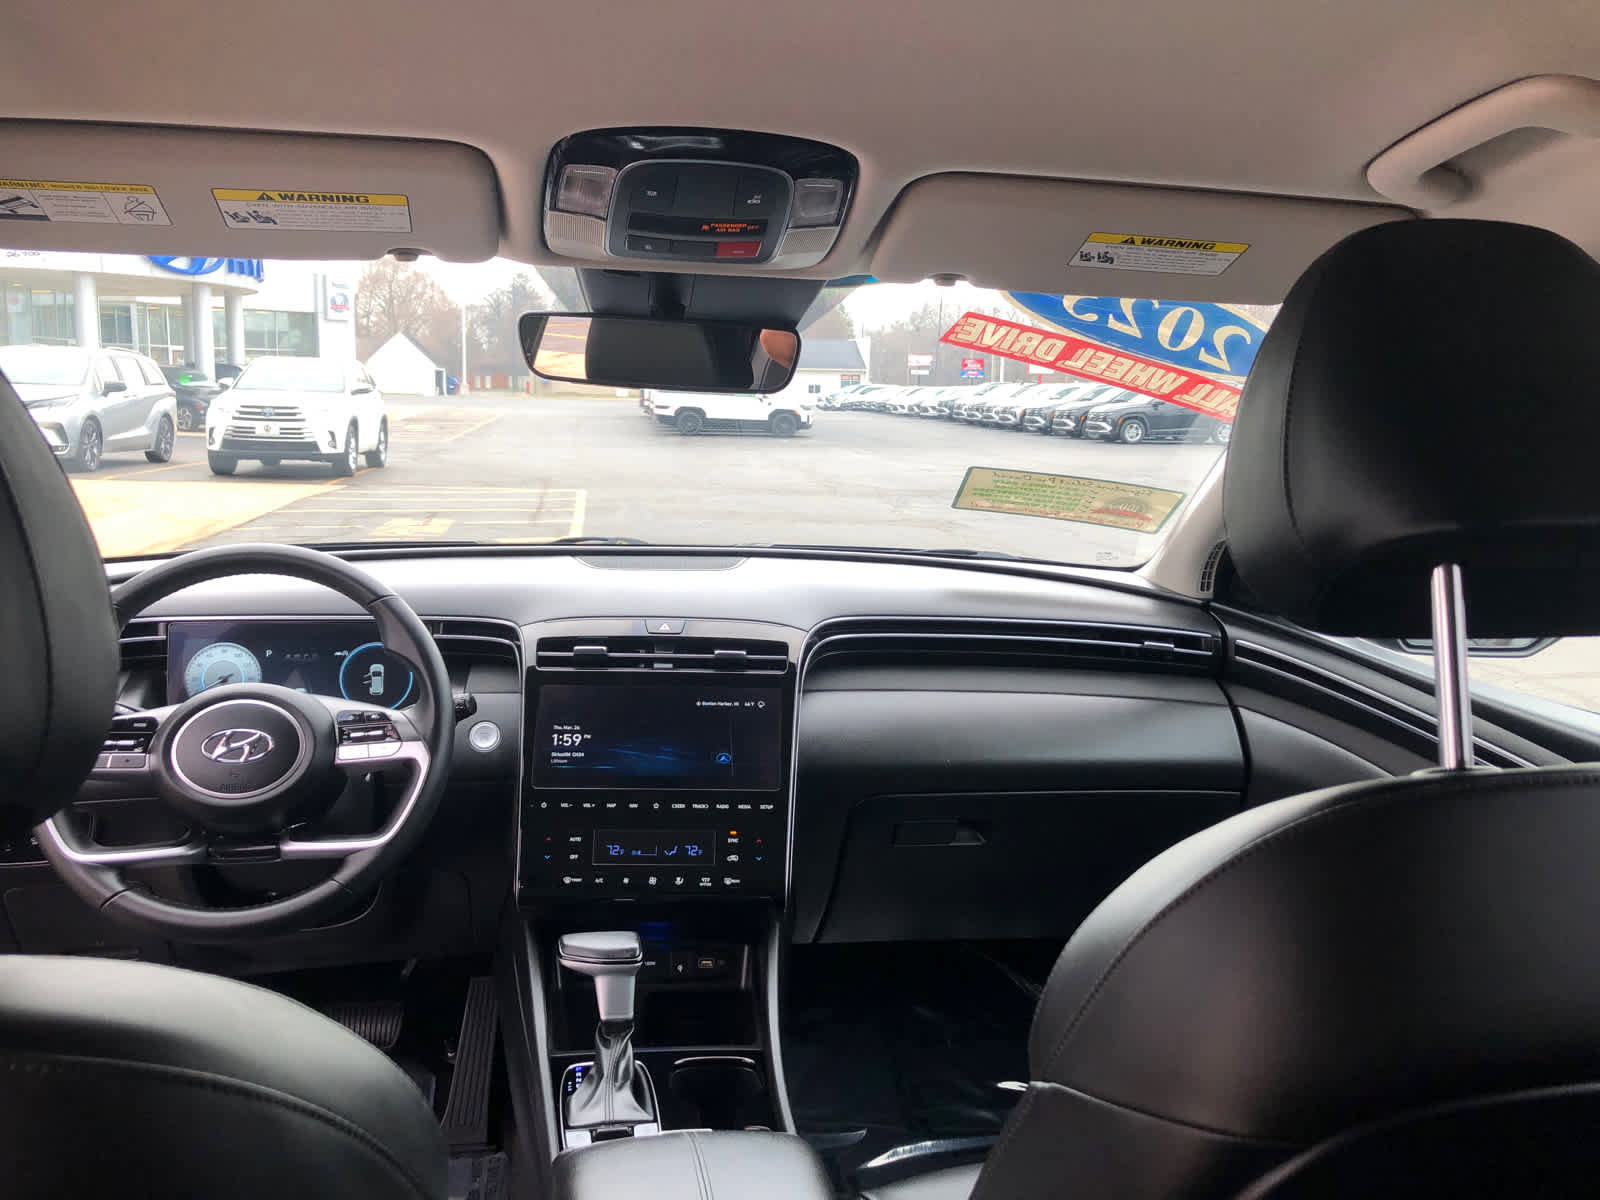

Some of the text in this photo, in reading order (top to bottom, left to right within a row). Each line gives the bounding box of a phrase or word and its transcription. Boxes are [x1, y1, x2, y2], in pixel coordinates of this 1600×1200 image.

[278, 193, 369, 204] WARNING
[1141, 237, 1217, 251] WARNING
[552, 733, 582, 746] 1:59
